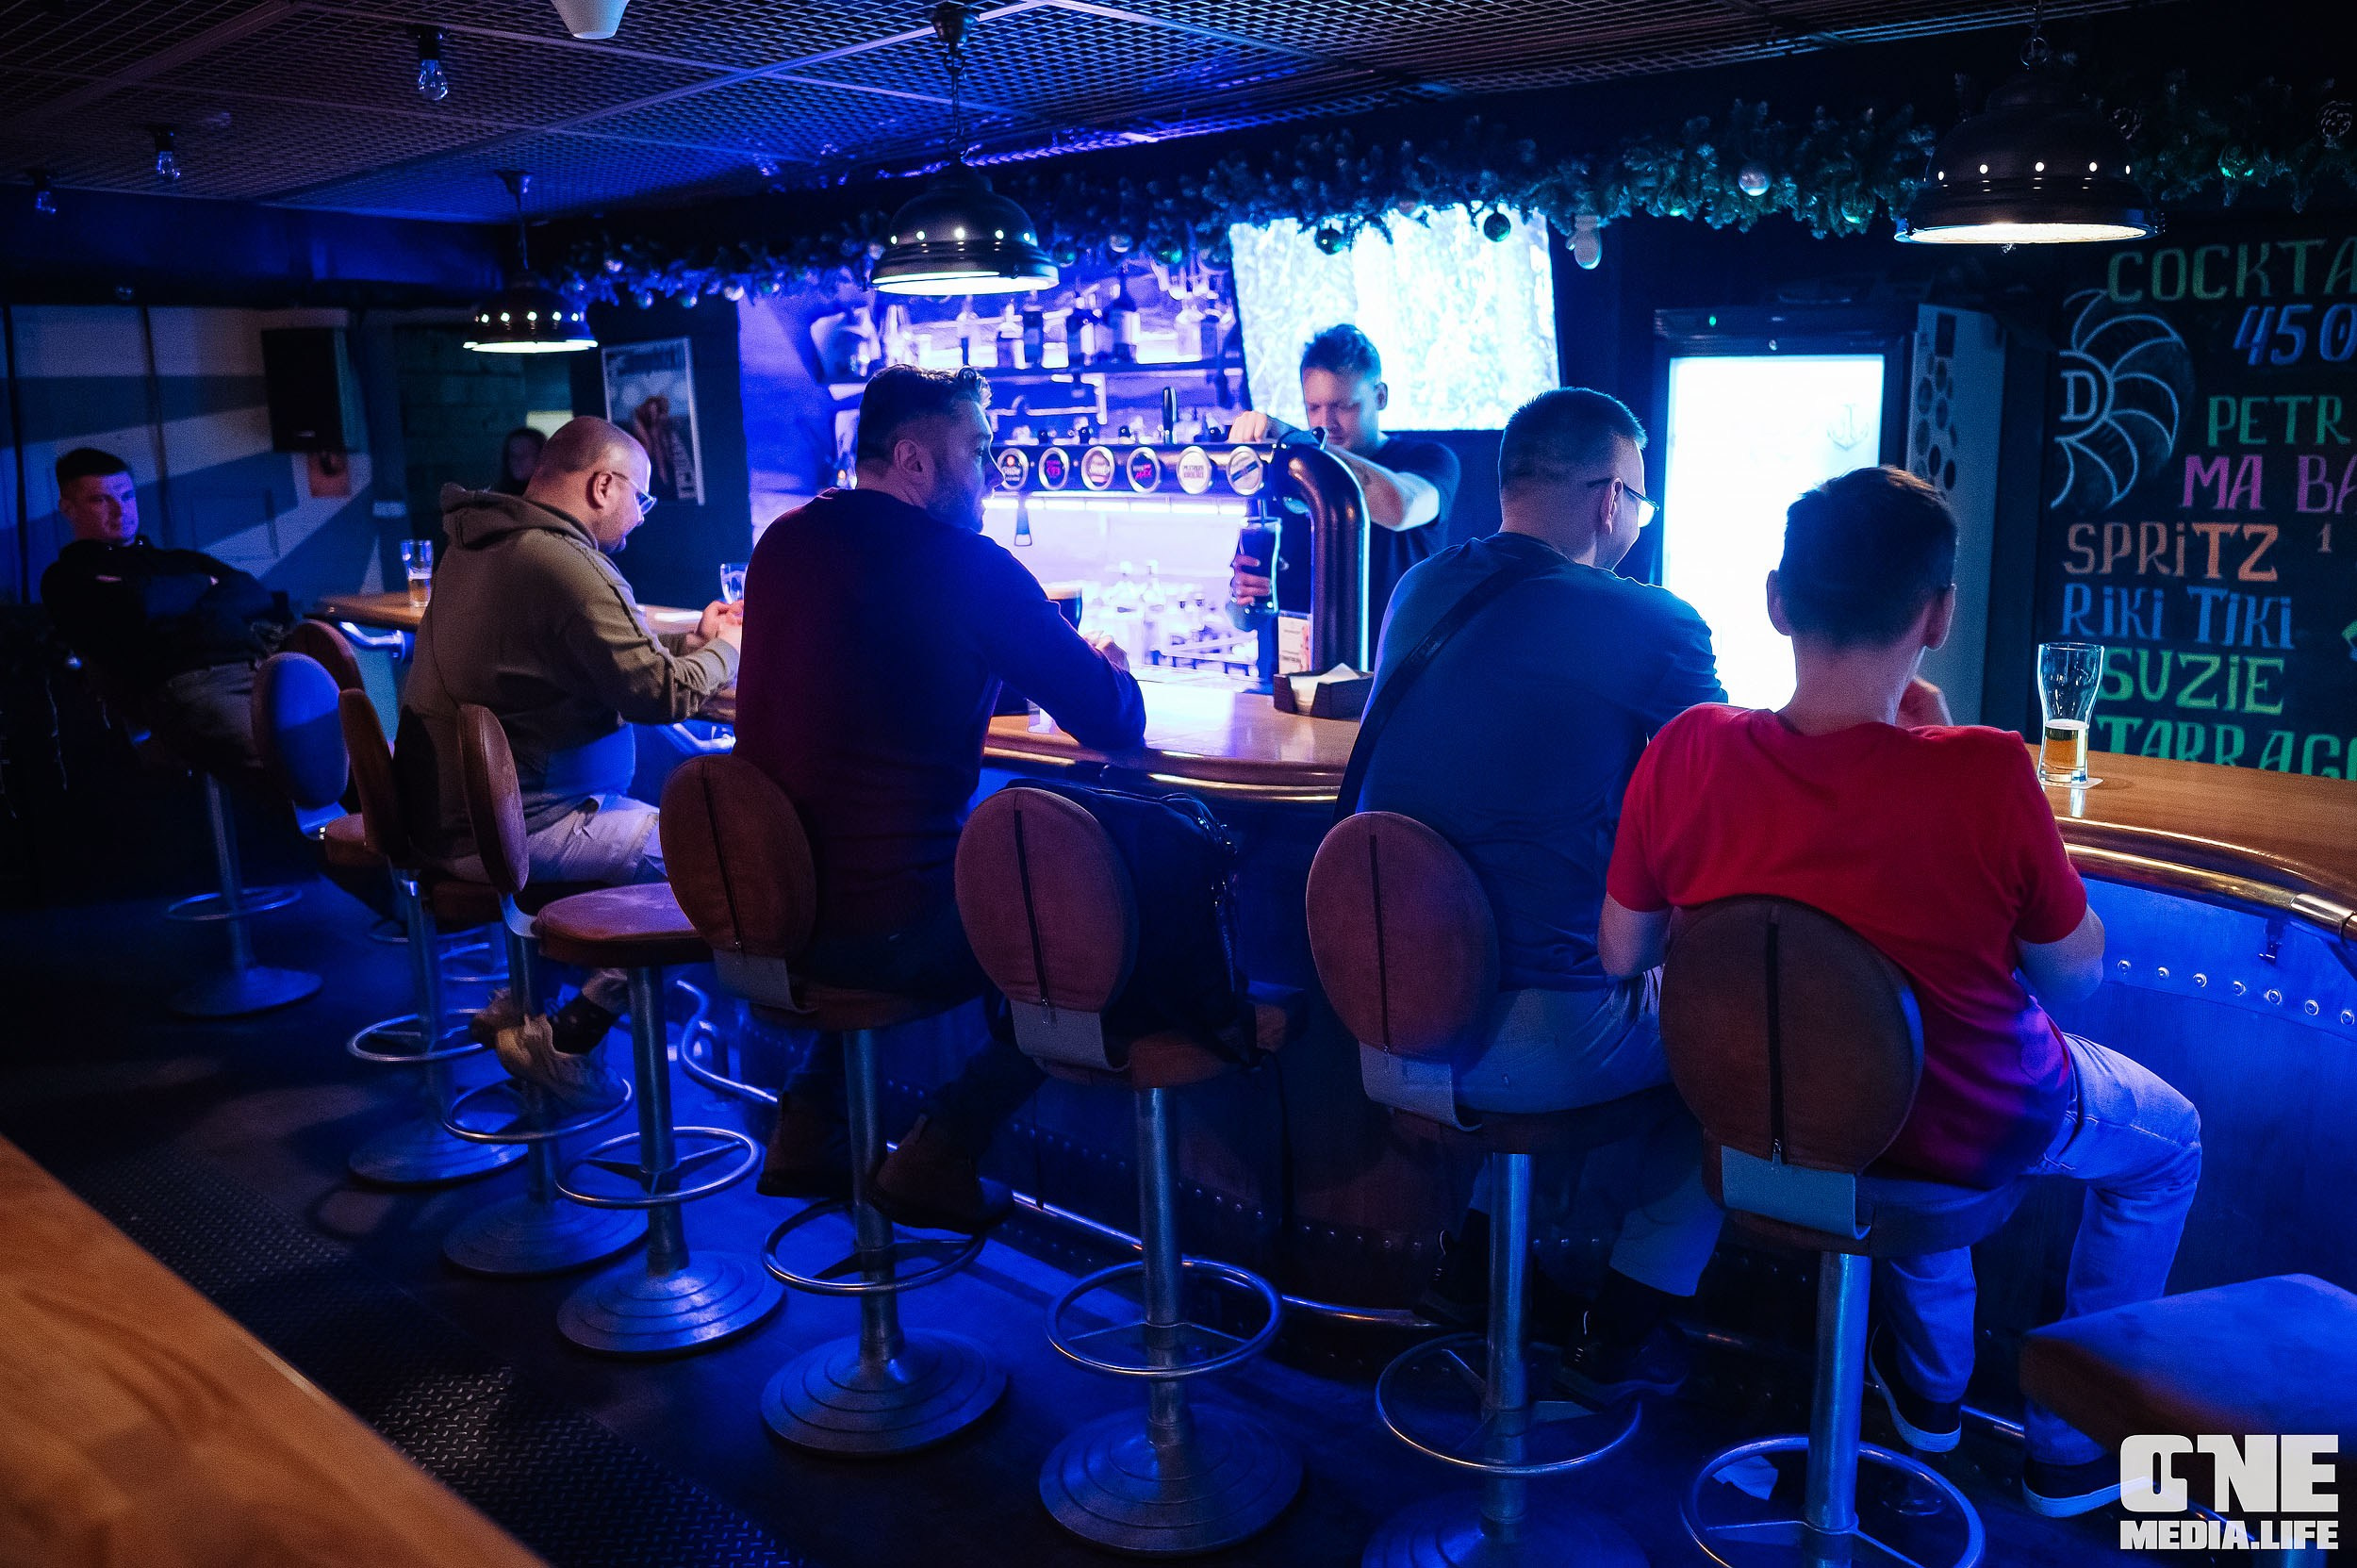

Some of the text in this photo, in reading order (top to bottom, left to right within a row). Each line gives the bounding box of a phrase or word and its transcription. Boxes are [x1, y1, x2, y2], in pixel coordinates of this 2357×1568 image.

[2233, 303, 2357, 365] 450
[2208, 394, 2351, 446] PETR
[2179, 454, 2266, 510] MA
[2096, 715, 2357, 782] TARRAG
